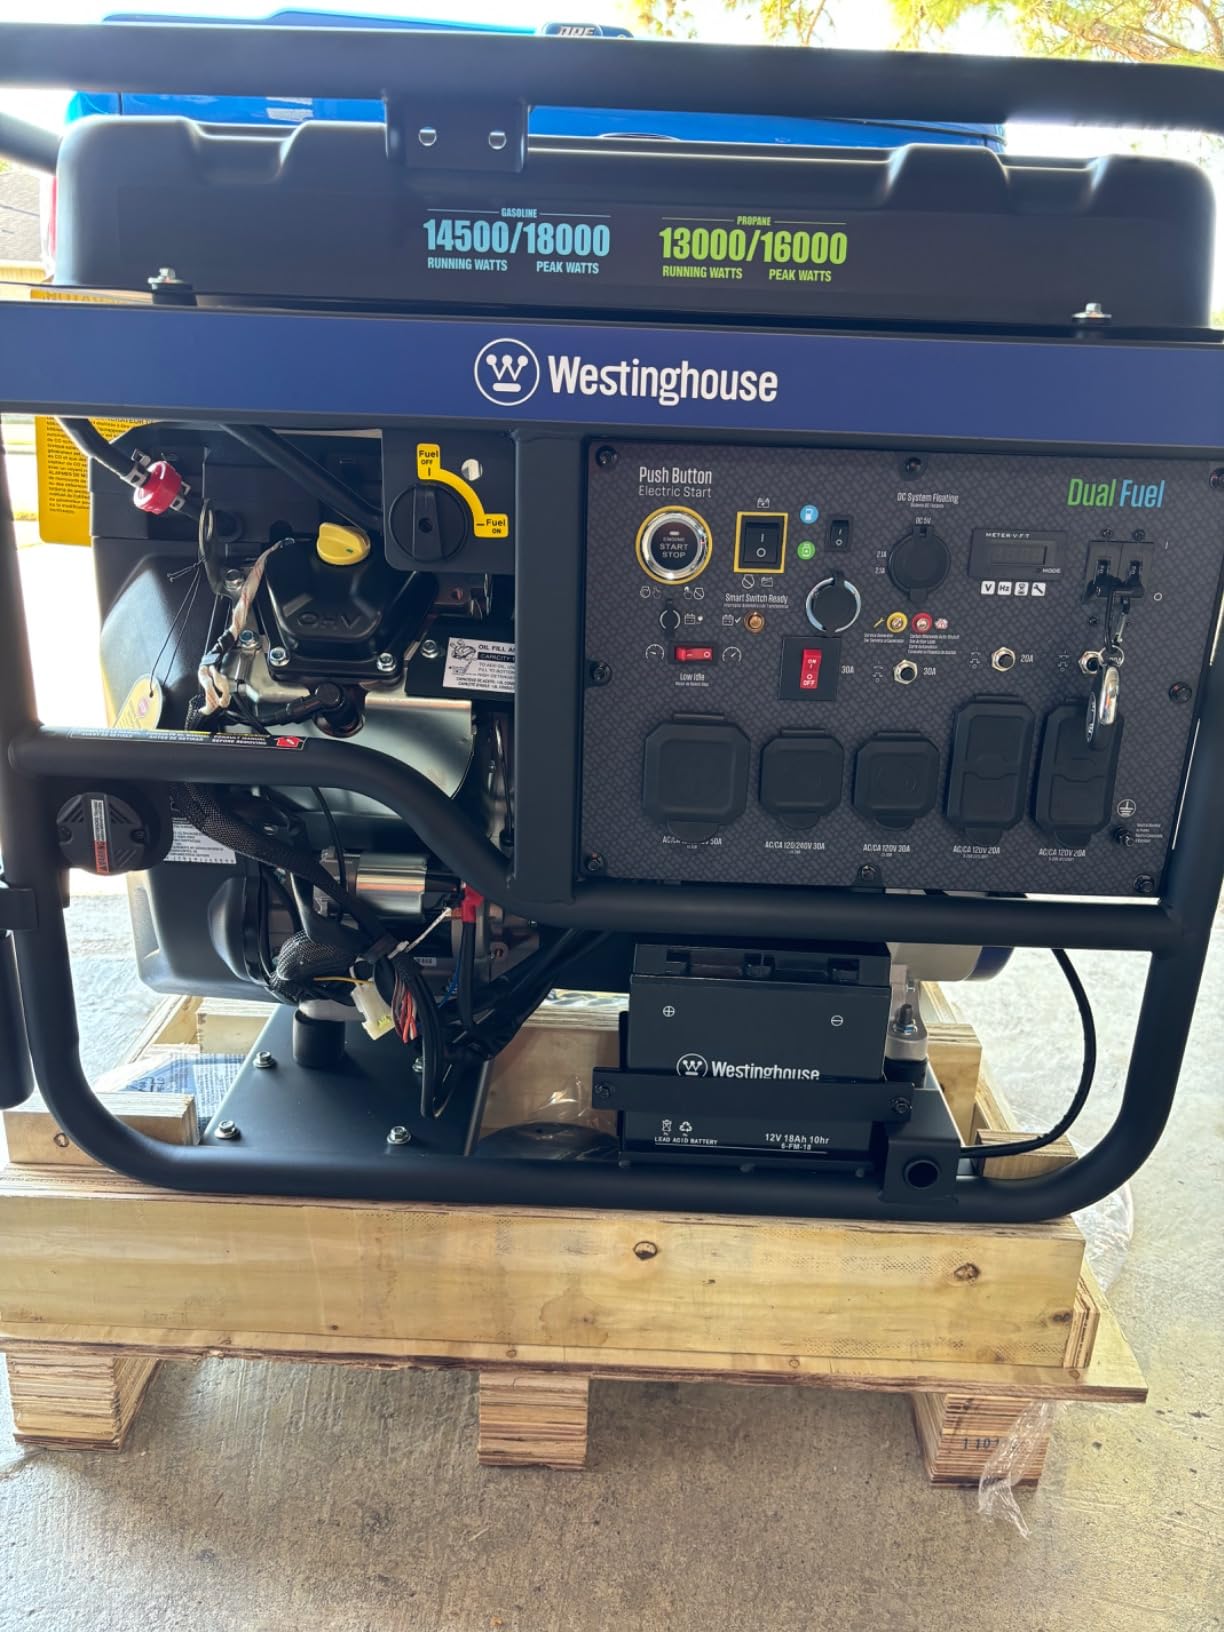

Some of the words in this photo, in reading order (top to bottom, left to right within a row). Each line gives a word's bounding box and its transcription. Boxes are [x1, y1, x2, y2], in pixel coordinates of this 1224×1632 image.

[501, 208, 537, 218] GASOLINE
[737, 216, 771, 226] PROPANE
[423, 219, 610, 256] 14500/18000
[659, 227, 847, 264] 13000/16000
[428, 257, 472, 270] RUNNING
[474, 259, 508, 271] WATTS
[536, 261, 563, 273] PEAK
[566, 262, 599, 274] WATTS
[662, 265, 707, 278] RUNNING
[709, 267, 743, 279] WATTS
[768, 269, 796, 281] PEAK
[799, 270, 832, 282] WATTS
[548, 355, 778, 406] Westinghouse
[418, 450, 439, 458] Fuel
[639, 466, 669, 483] Push
[671, 467, 712, 485] Button
[638, 485, 681, 497] Electric
[683, 486, 712, 498] Start
[1067, 478, 1117, 507] Dual
[1119, 479, 1165, 507] Fuel
[897, 492, 907, 501] DC
[907, 492, 932, 503] System
[933, 493, 959, 504] Floating
[486, 519, 506, 527] Fuel
[660, 543, 689, 551] START
[662, 551, 687, 559] STOP
[985, 584, 992, 592] V
[1000, 584, 1010, 592] Hz
[725, 592, 745, 602] Smart
[745, 593, 767, 603] Switch
[768, 594, 788, 604] Ready
[1020, 654, 1034, 663] 20A
[840, 665, 855, 674] 30A
[923, 667, 936, 676] 30A
[680, 672, 693, 681] Low
[882, 844, 897, 852] 120V
[988, 846, 1001, 854] 20A
[1058, 848, 1073, 857] 120V
[1073, 849, 1086, 857] 20A
[765, 1133, 782, 1142] 12V
[784, 1135, 807, 1144] 18Ah
[810, 1136, 830, 1145] 10hr
